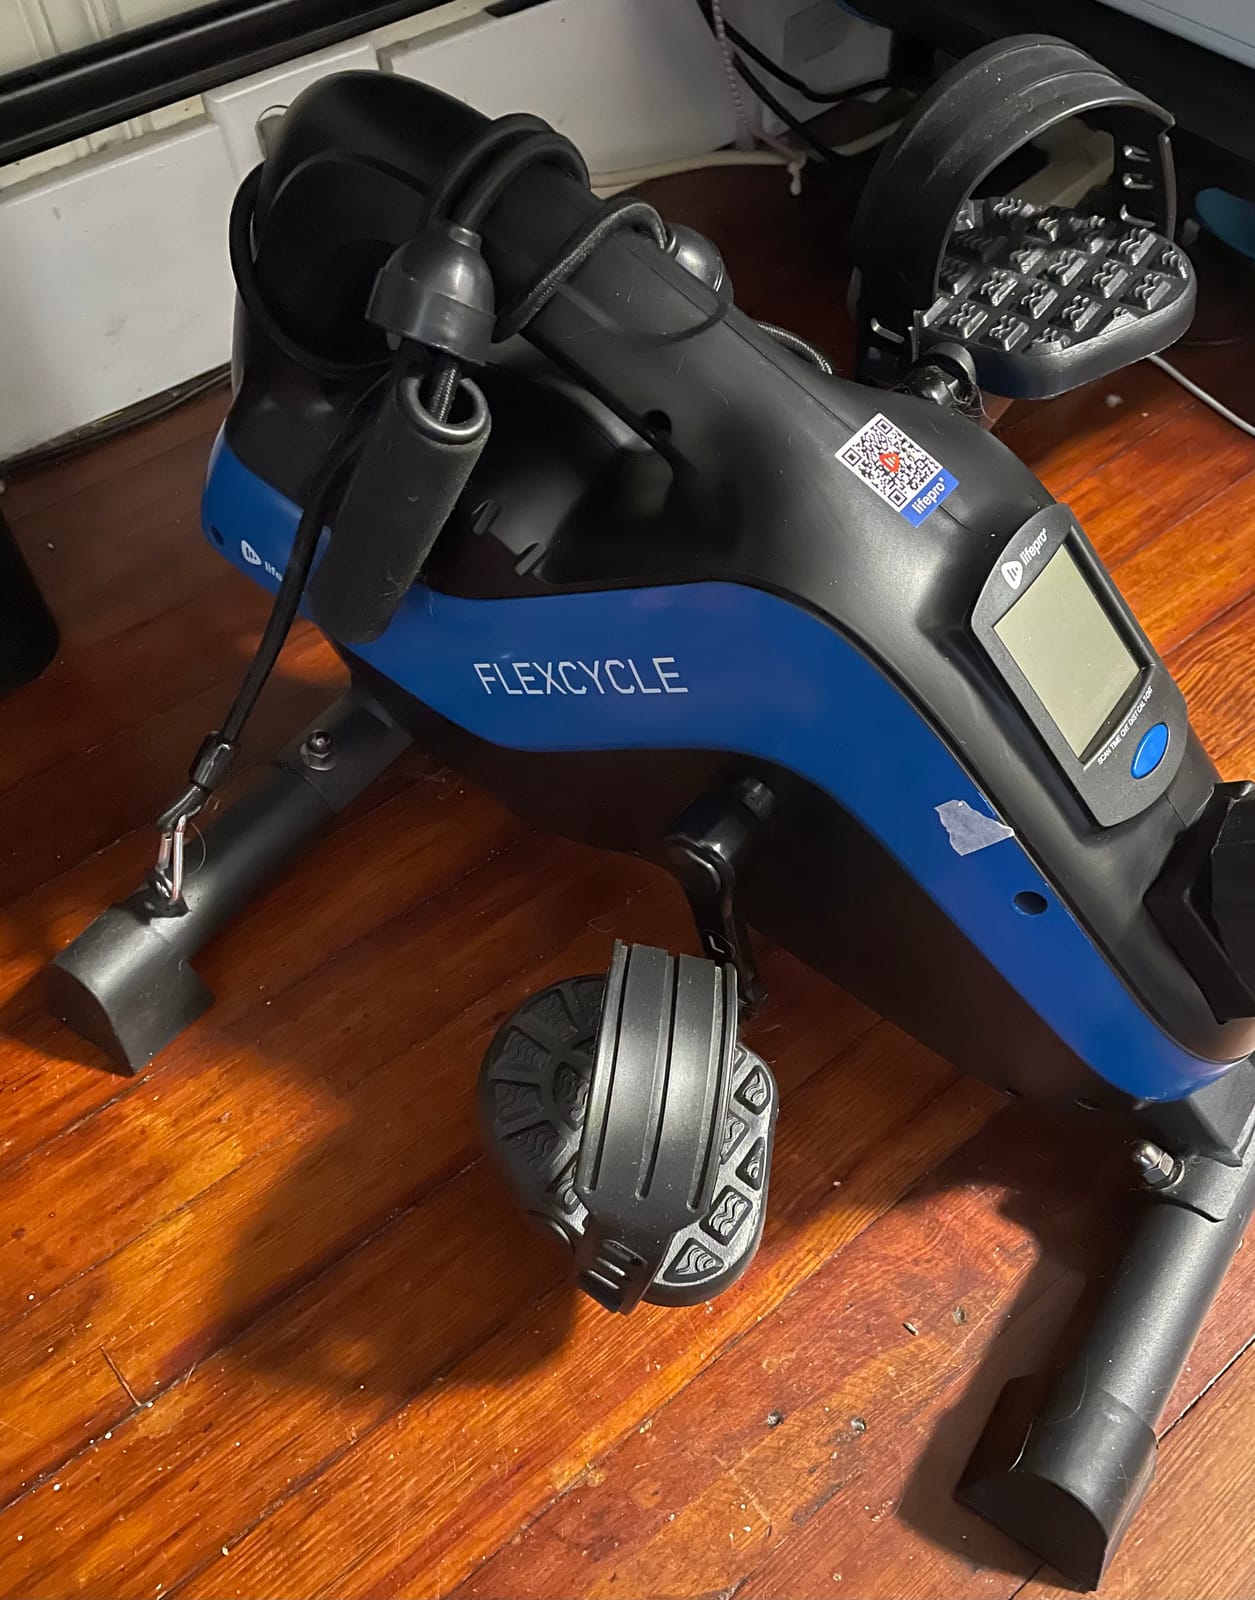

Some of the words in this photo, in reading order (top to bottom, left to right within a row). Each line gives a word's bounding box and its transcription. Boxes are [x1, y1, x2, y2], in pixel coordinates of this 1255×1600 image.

[1019, 531, 1048, 566] lifepro
[473, 656, 689, 695] FLEXCYCLE
[1097, 747, 1112, 765] SCAN
[1110, 735, 1123, 750] TIME
[1128, 711, 1139, 726] DIST
[1136, 701, 1146, 713] CAL
